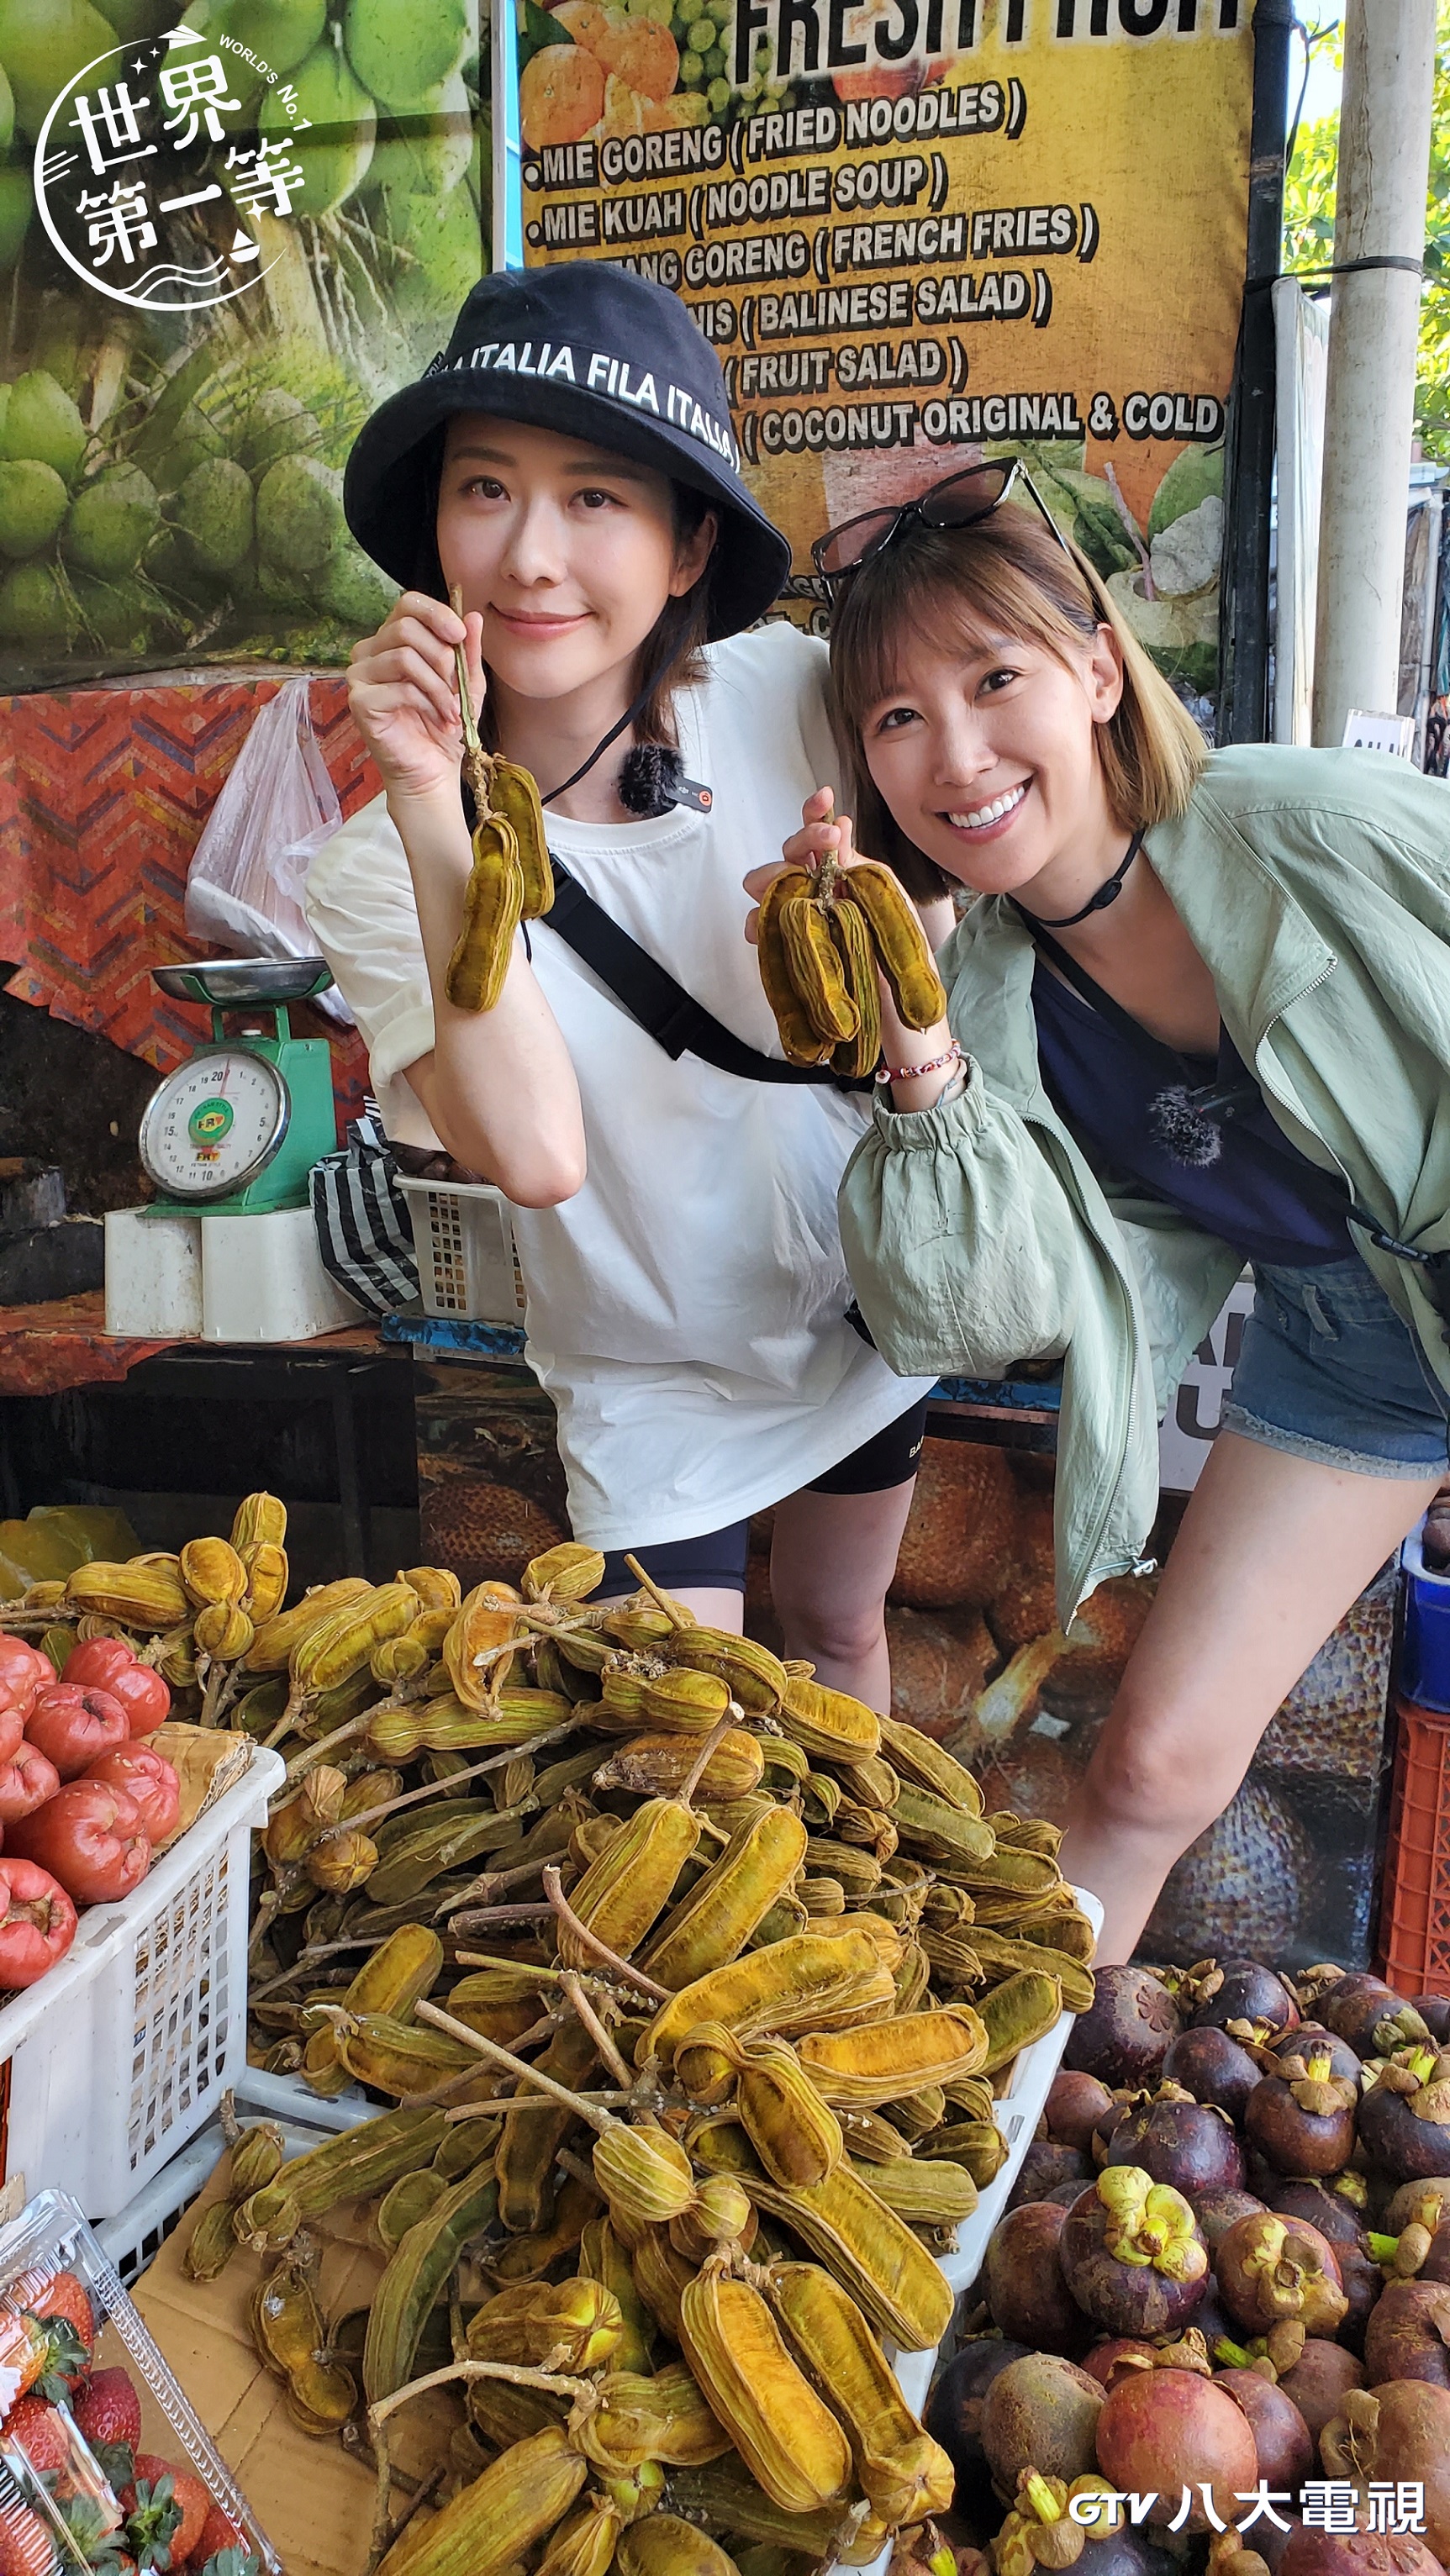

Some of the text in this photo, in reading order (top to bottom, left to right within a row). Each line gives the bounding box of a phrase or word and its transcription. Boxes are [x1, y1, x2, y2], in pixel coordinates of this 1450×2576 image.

[541, 142, 597, 187] MIE
[601, 125, 726, 181] GORENG
[543, 202, 598, 247] MIE
[603, 190, 684, 241] KUAH
[685, 231, 808, 287] GORENG
[470, 341, 576, 383] ITALIA
[588, 353, 660, 414] FILA
[667, 384, 734, 467] ITALIA
[924, 395, 1083, 441] ORIGINAL
[1090, 394, 1118, 435] &
[1124, 395, 1222, 439] COLD
[211, 1071, 224, 1082] 20
